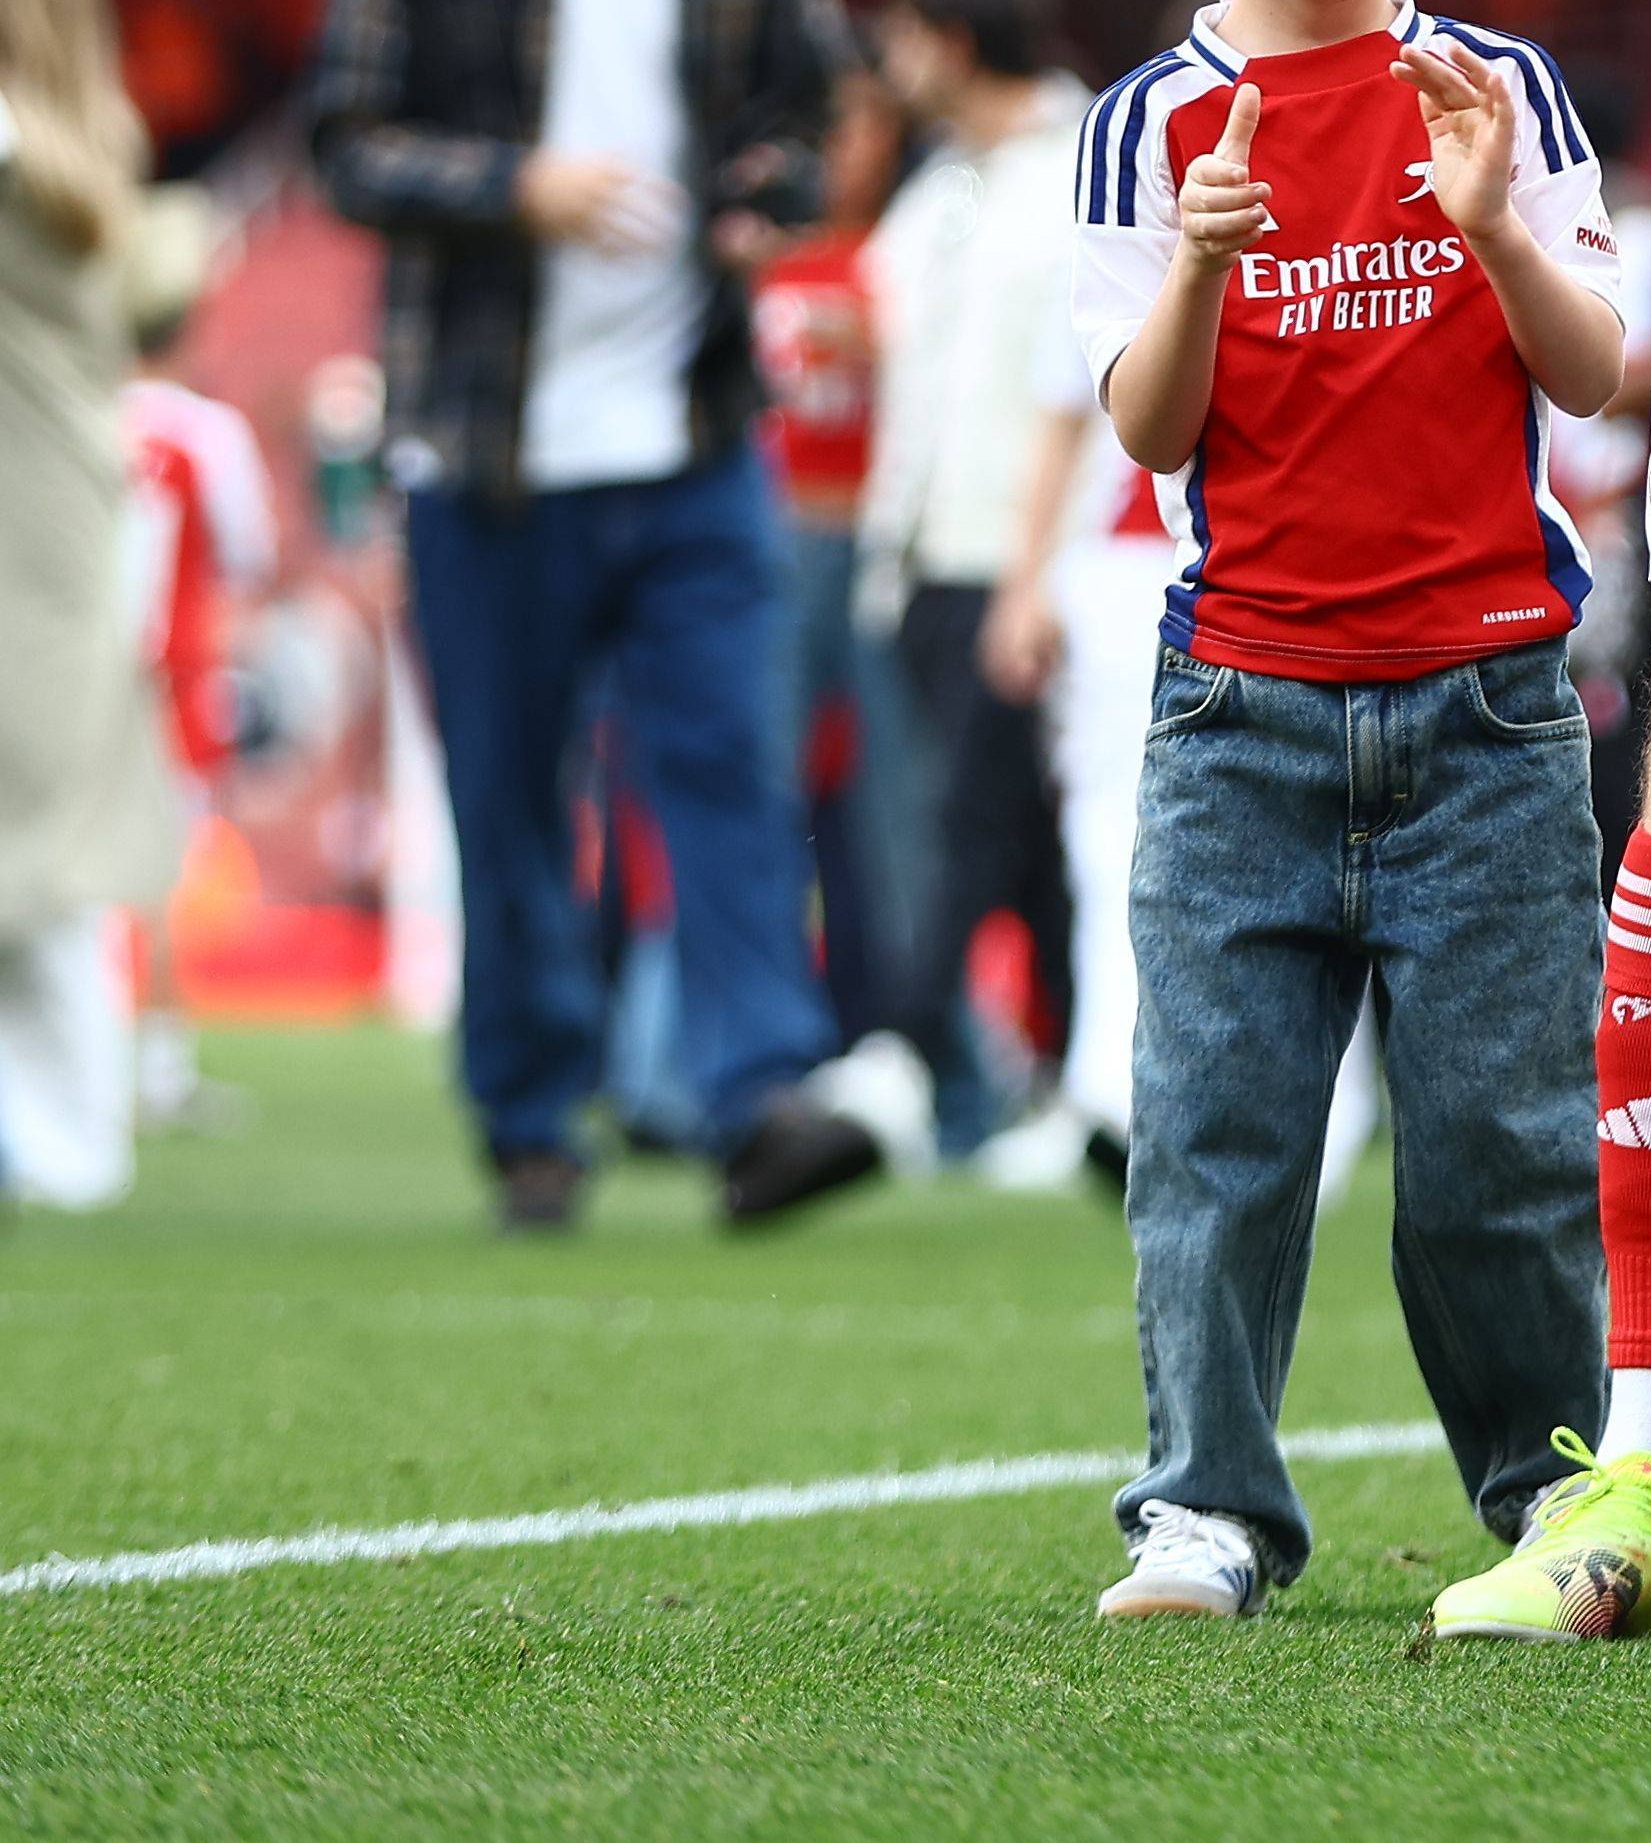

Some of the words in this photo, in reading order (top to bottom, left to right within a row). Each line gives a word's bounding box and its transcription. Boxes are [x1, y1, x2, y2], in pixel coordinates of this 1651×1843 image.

[1240, 234, 1465, 299] Emirates
[1277, 293, 1326, 338] FLY
[1332, 285, 1433, 332] BETTER
[1482, 606, 1547, 625] AEROREADY
